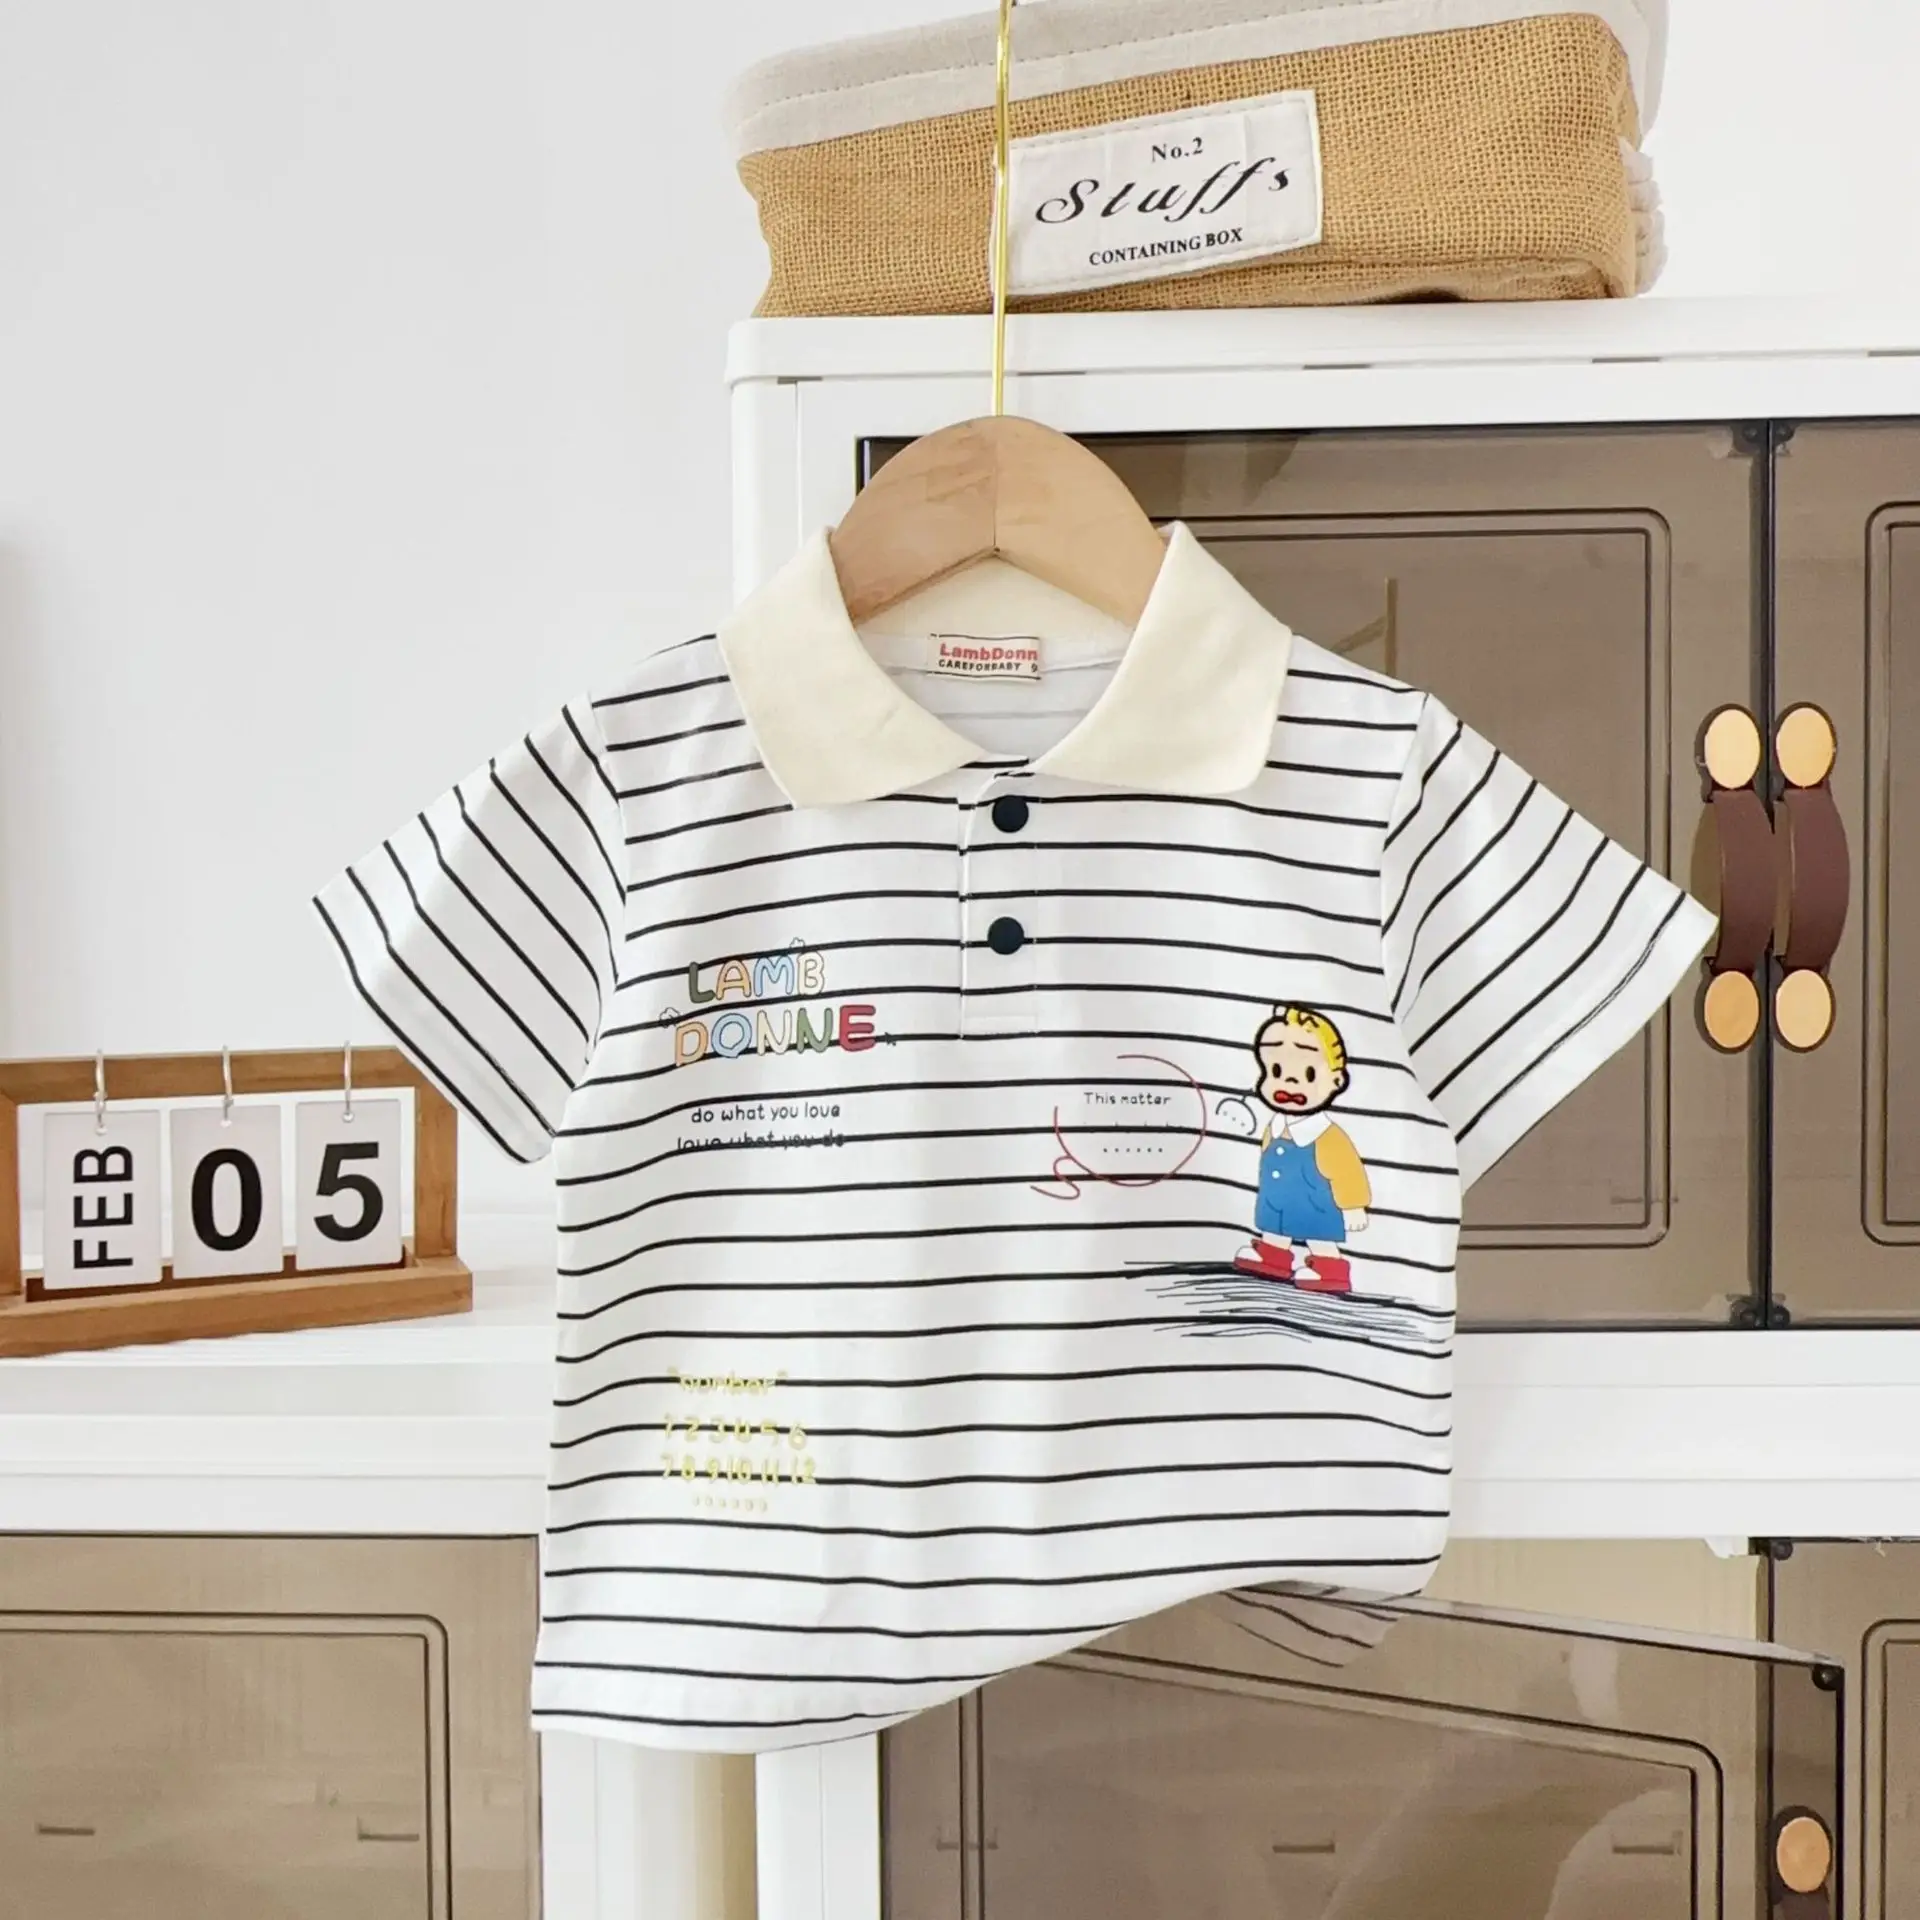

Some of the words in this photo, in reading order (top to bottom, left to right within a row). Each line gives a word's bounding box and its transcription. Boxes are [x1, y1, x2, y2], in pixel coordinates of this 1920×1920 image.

[1152, 137, 1203, 162] No.2
[1035, 156, 1291, 224] Stuffs
[1089, 235, 1201, 266] CONTAINING
[1205, 227, 1243, 246] BOX
[688, 950, 825, 1004] LAMB
[675, 1004, 877, 1067] DONNE
[691, 1107, 714, 1123] do
[721, 1103, 765, 1121] what
[770, 1106, 799, 1122] you
[804, 1102, 841, 1118] love
[1083, 1092, 1116, 1104] This
[1120, 1092, 1171, 1105] matter
[74, 1145, 133, 1269] FEB
